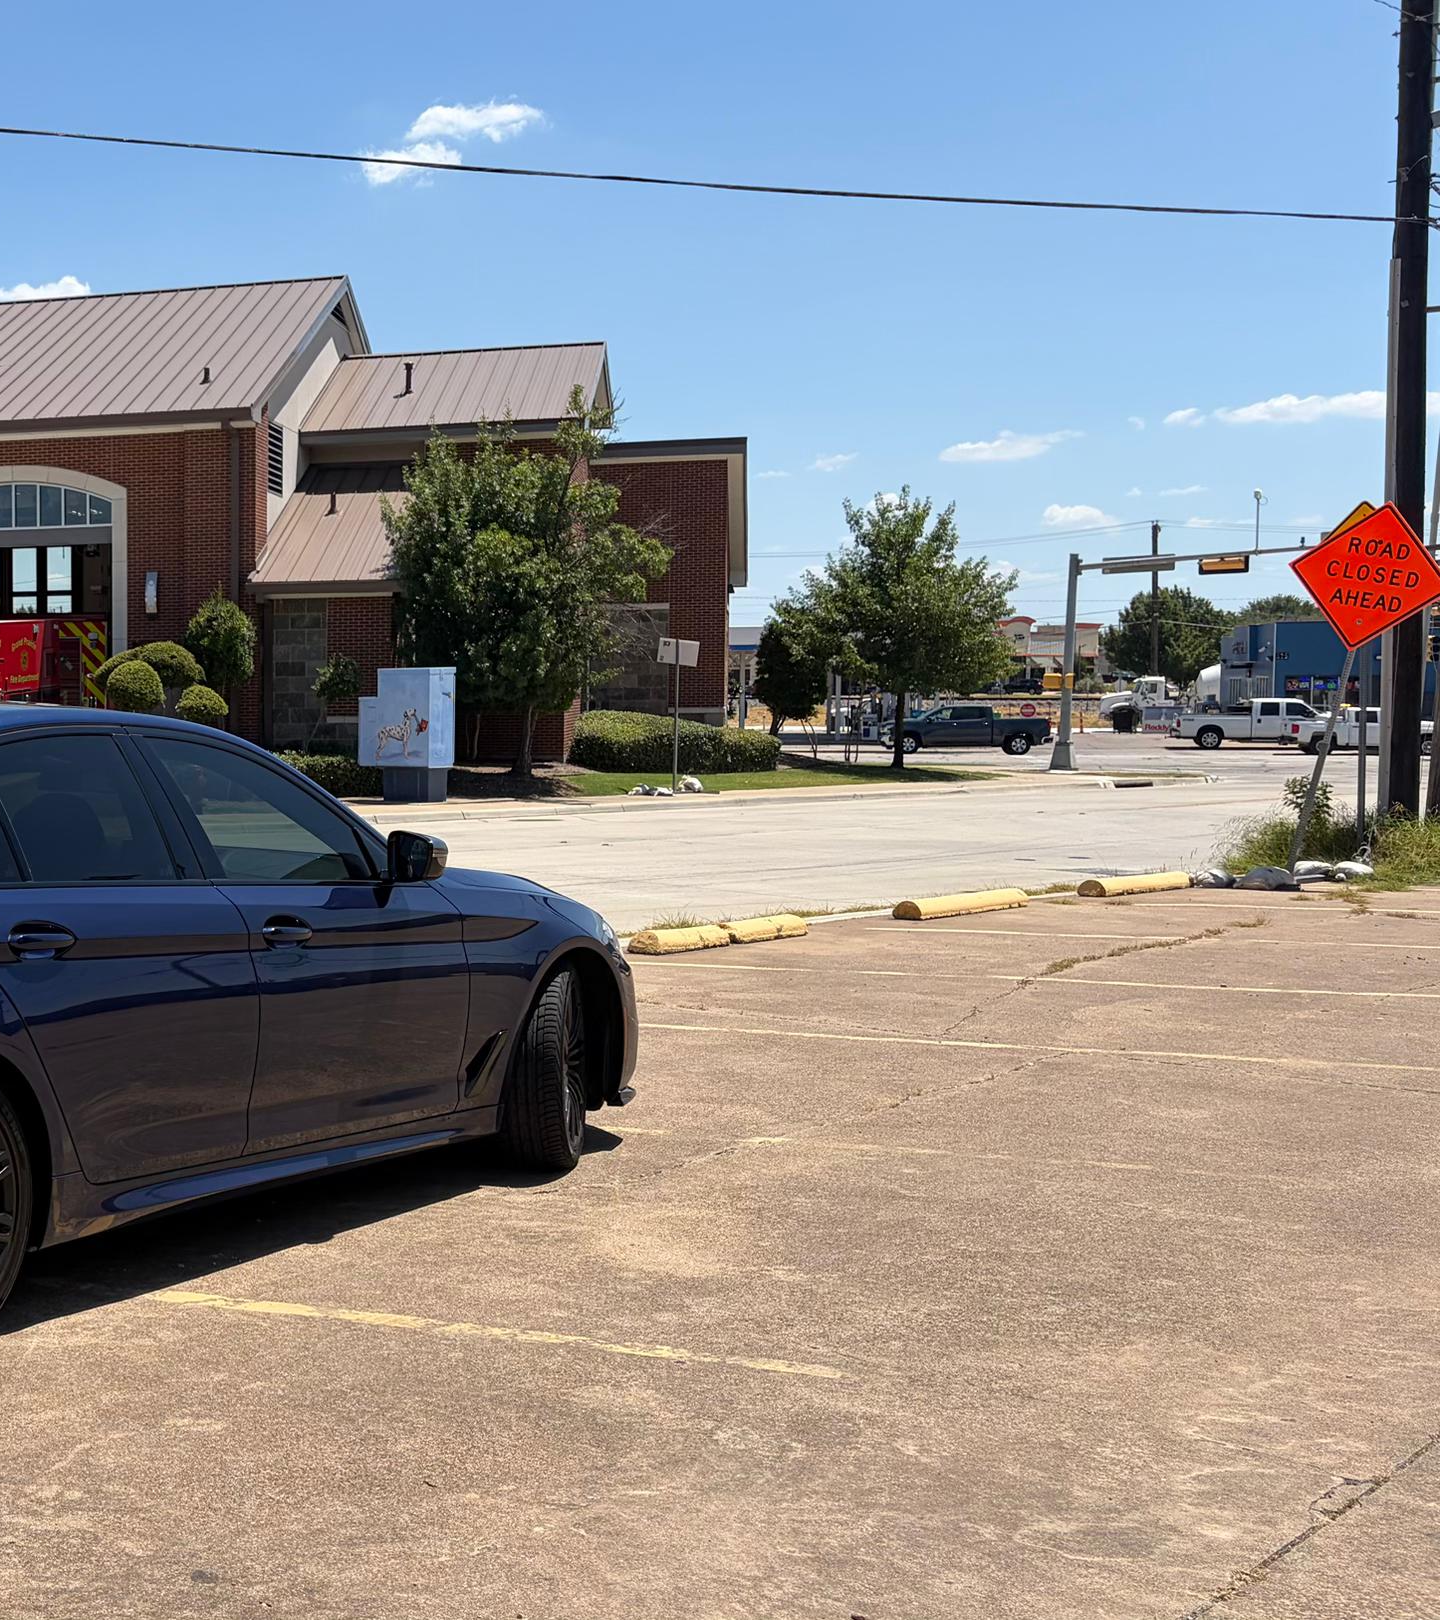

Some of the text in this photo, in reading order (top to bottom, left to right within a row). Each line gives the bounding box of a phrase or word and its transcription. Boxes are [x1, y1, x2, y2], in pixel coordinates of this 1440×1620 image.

[1347, 537, 1411, 560] ROAD
[1326, 560, 1420, 588] CLOSED
[1329, 588, 1402, 613] AHEAD
